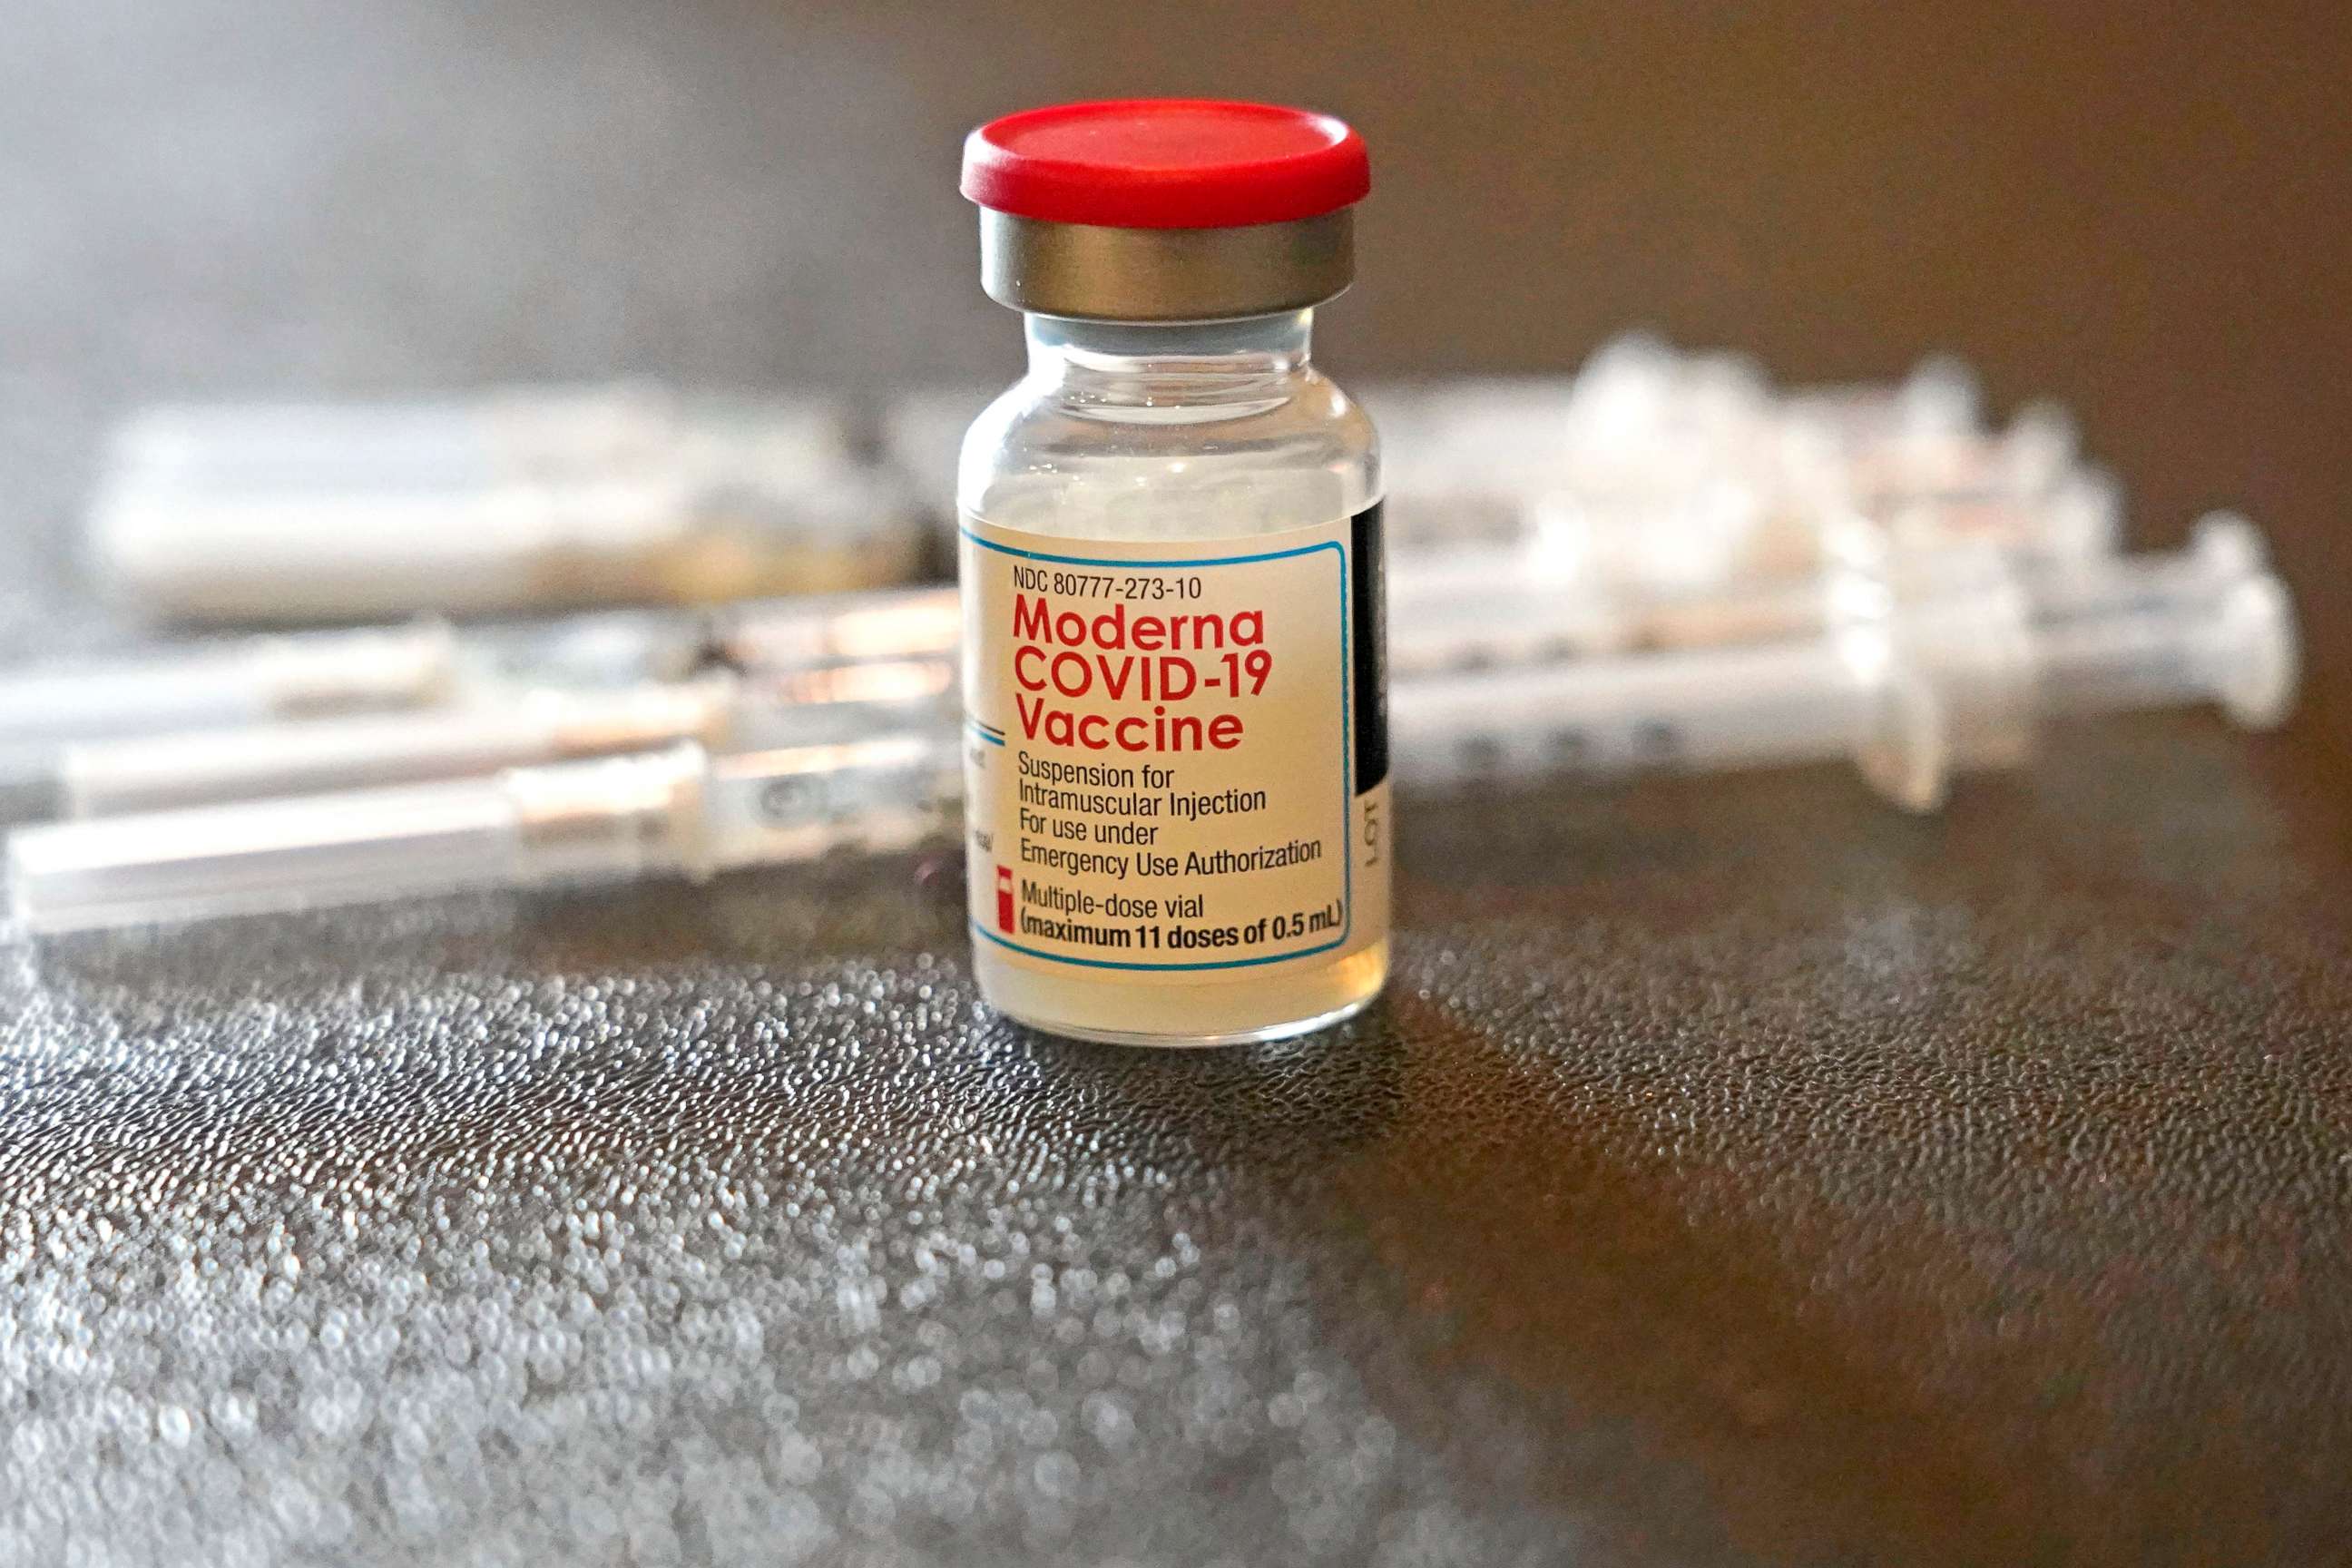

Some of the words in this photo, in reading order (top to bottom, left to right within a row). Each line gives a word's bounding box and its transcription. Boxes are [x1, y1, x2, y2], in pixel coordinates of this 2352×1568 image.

[1013, 565, 1048, 593] NDC
[1054, 573, 1201, 600] 80777-273-10
[1013, 593, 1264, 652] Moderna
[1014, 645, 1272, 701] COVID-19
[1016, 693, 1244, 752] Vaccine
[1018, 751, 1134, 789] Suspension
[1142, 764, 1174, 789] for
[1019, 779, 1161, 817] Intramuscular
[1170, 789, 1266, 820] Injection
[1020, 808, 1045, 835] For
[1053, 821, 1087, 841] use
[1094, 822, 1159, 846] under
[1021, 838, 1129, 880] Emergency
[1137, 853, 1179, 877] Use
[1184, 839, 1322, 876] Authorization
[1021, 879, 1157, 918] Multiple-dose
[1163, 894, 1204, 918] vial
[1021, 907, 1131, 947] (maximum
[1135, 925, 1161, 948] 11
[1167, 924, 1239, 949] doses
[1244, 918, 1267, 946] of
[1272, 913, 1305, 939] 0.5
[1308, 898, 1343, 934] mL)
